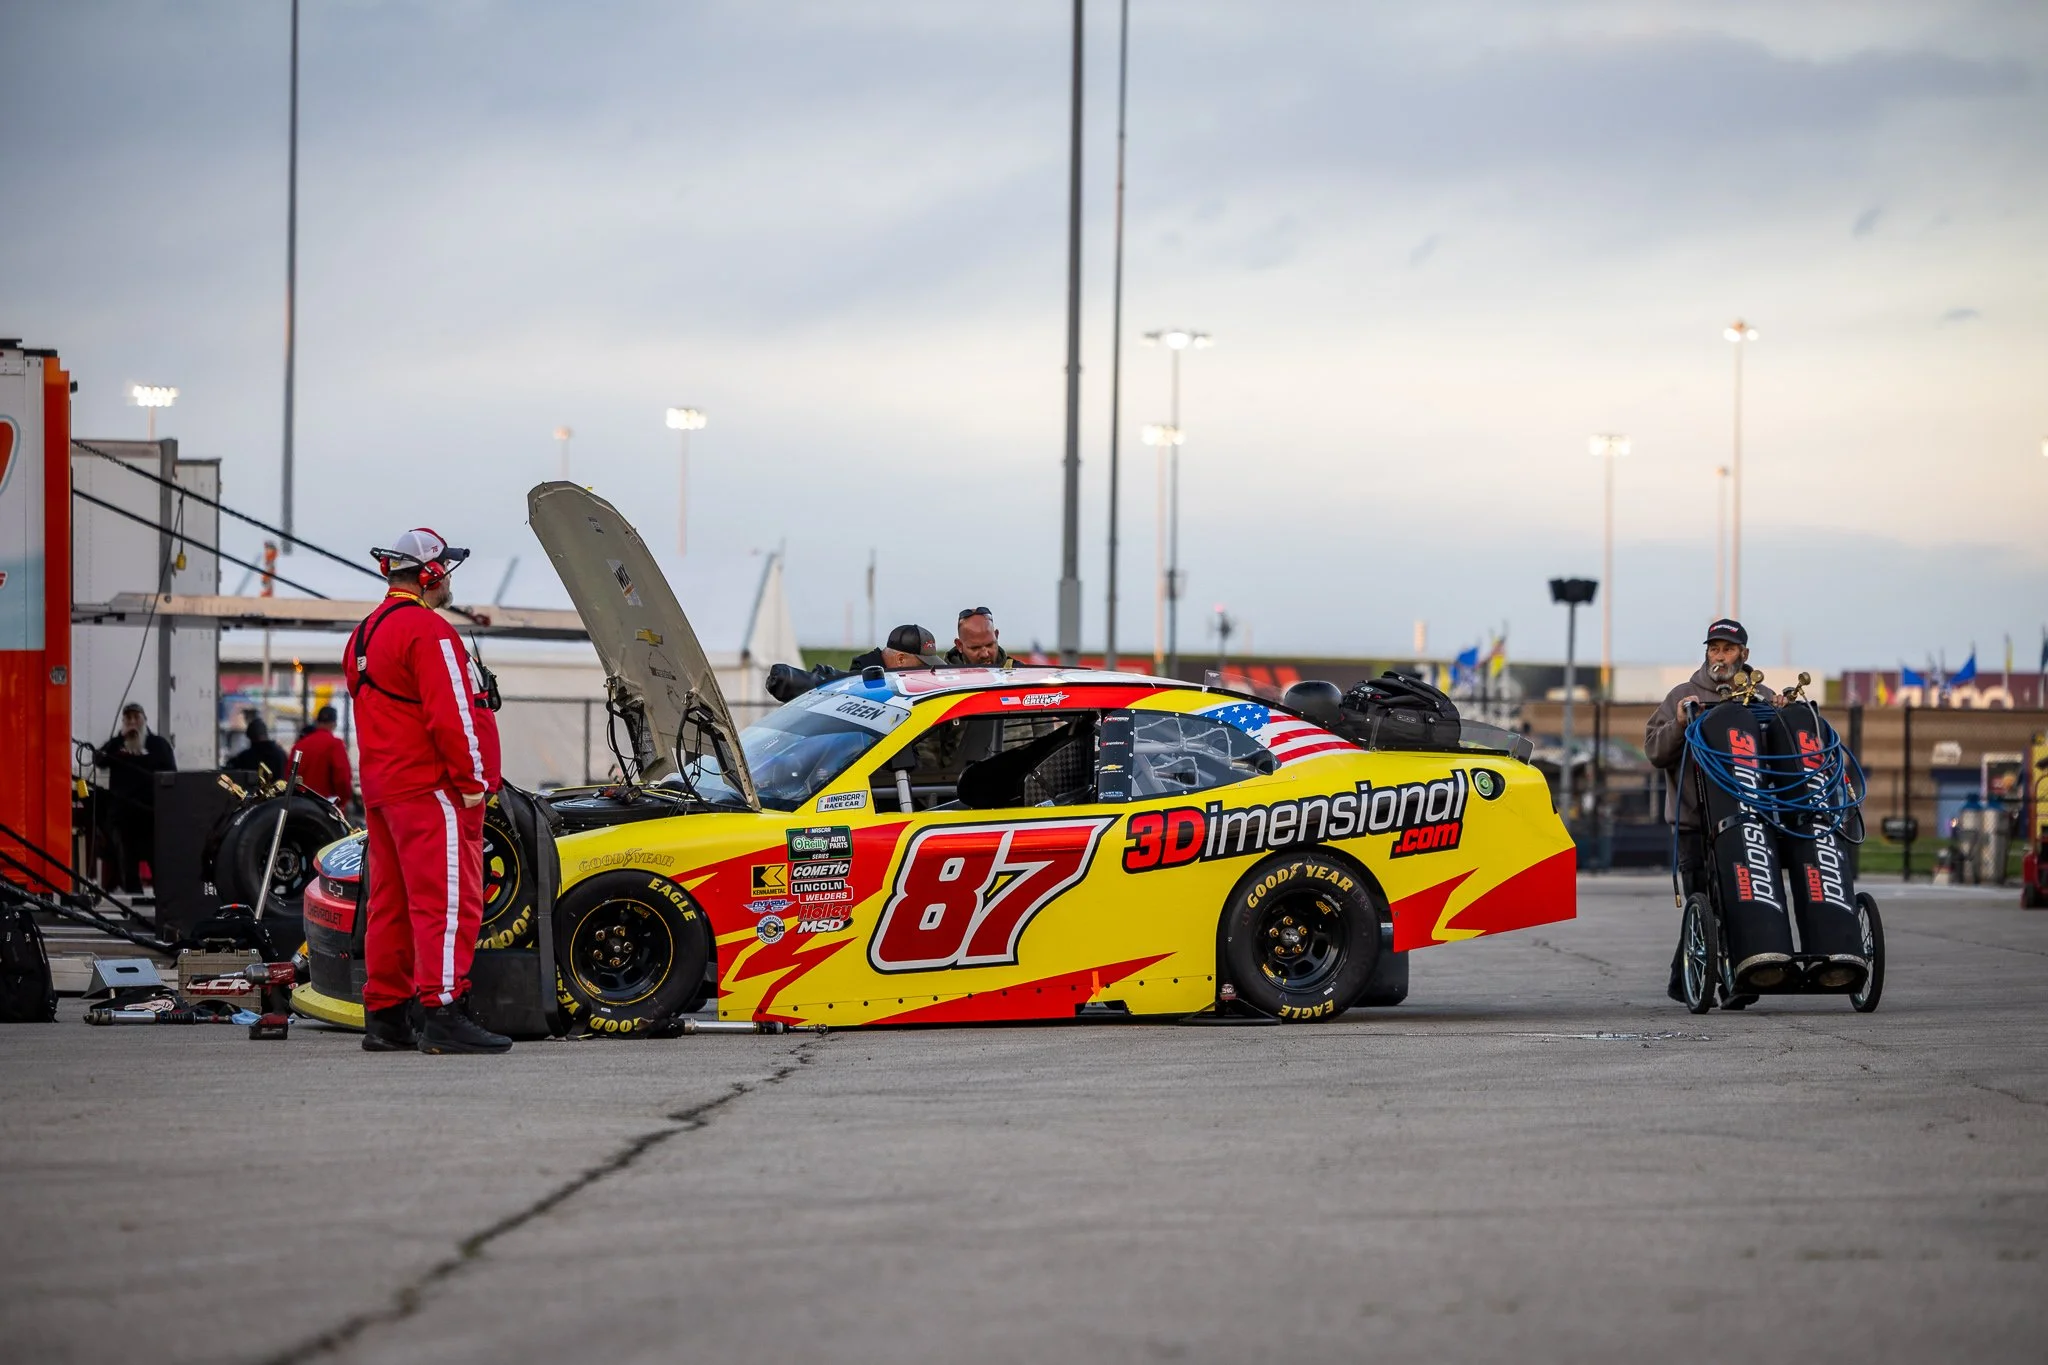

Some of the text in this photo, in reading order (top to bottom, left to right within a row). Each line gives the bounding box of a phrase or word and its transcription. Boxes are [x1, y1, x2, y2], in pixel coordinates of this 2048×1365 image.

[836, 702, 885, 720] GREEN
[831, 793, 861, 802] NASCAR
[1126, 772, 1467, 869] 3Dimensional
[793, 836, 828, 851] O'Reilly
[1396, 822, 1460, 853] .com
[793, 863, 849, 877] COMETIC
[794, 882, 842, 892] LINCOLN
[1736, 864, 1753, 900] .com
[1807, 866, 1824, 901] .com
[647, 877, 697, 922] EAGLE
[753, 888, 786, 896] KENNAMETAL
[806, 892, 848, 901] WELDERS
[869, 815, 1118, 974] 87
[308, 903, 342, 925] CHEVROLET
[799, 903, 852, 921] Holley
[797, 919, 844, 934] MSD
[1278, 999, 1335, 1020] EAGLE
